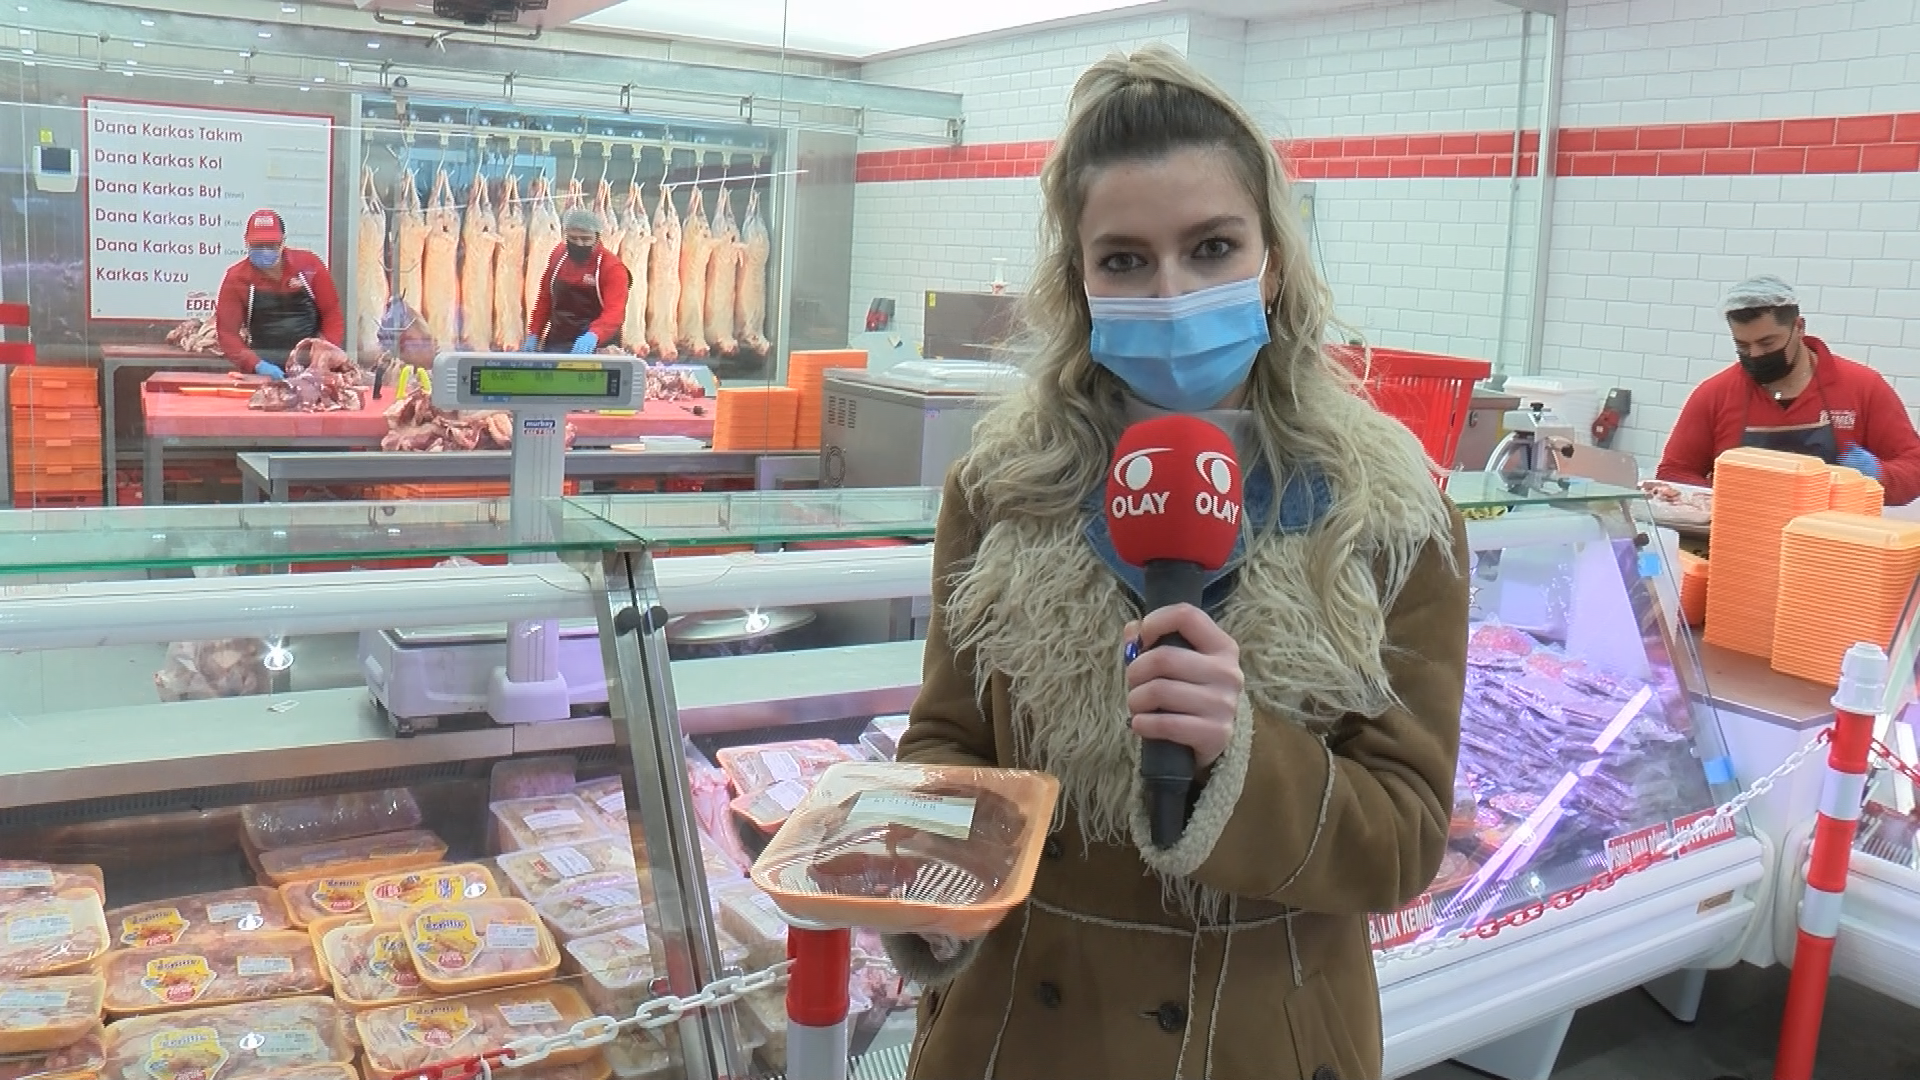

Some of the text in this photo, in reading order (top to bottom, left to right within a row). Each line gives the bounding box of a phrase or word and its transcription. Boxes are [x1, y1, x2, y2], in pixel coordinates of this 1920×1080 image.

[94, 119, 243, 142] Dana Karkas Takım
[94, 148, 222, 170] Dana Karkas Kol
[95, 178, 137, 194] Dana
[142, 181, 194, 197] Karkas
[199, 185, 221, 198] But
[95, 208, 137, 223] Dana
[143, 210, 194, 226] Karkas
[199, 213, 221, 227] But
[96, 238, 138, 252] Dana
[143, 239, 194, 255] Karkas
[199, 242, 221, 255] But
[96, 267, 189, 283] Karkas Kuzu
[1111, 491, 1171, 519] OLAY
[1195, 491, 1240, 525] OLAY
